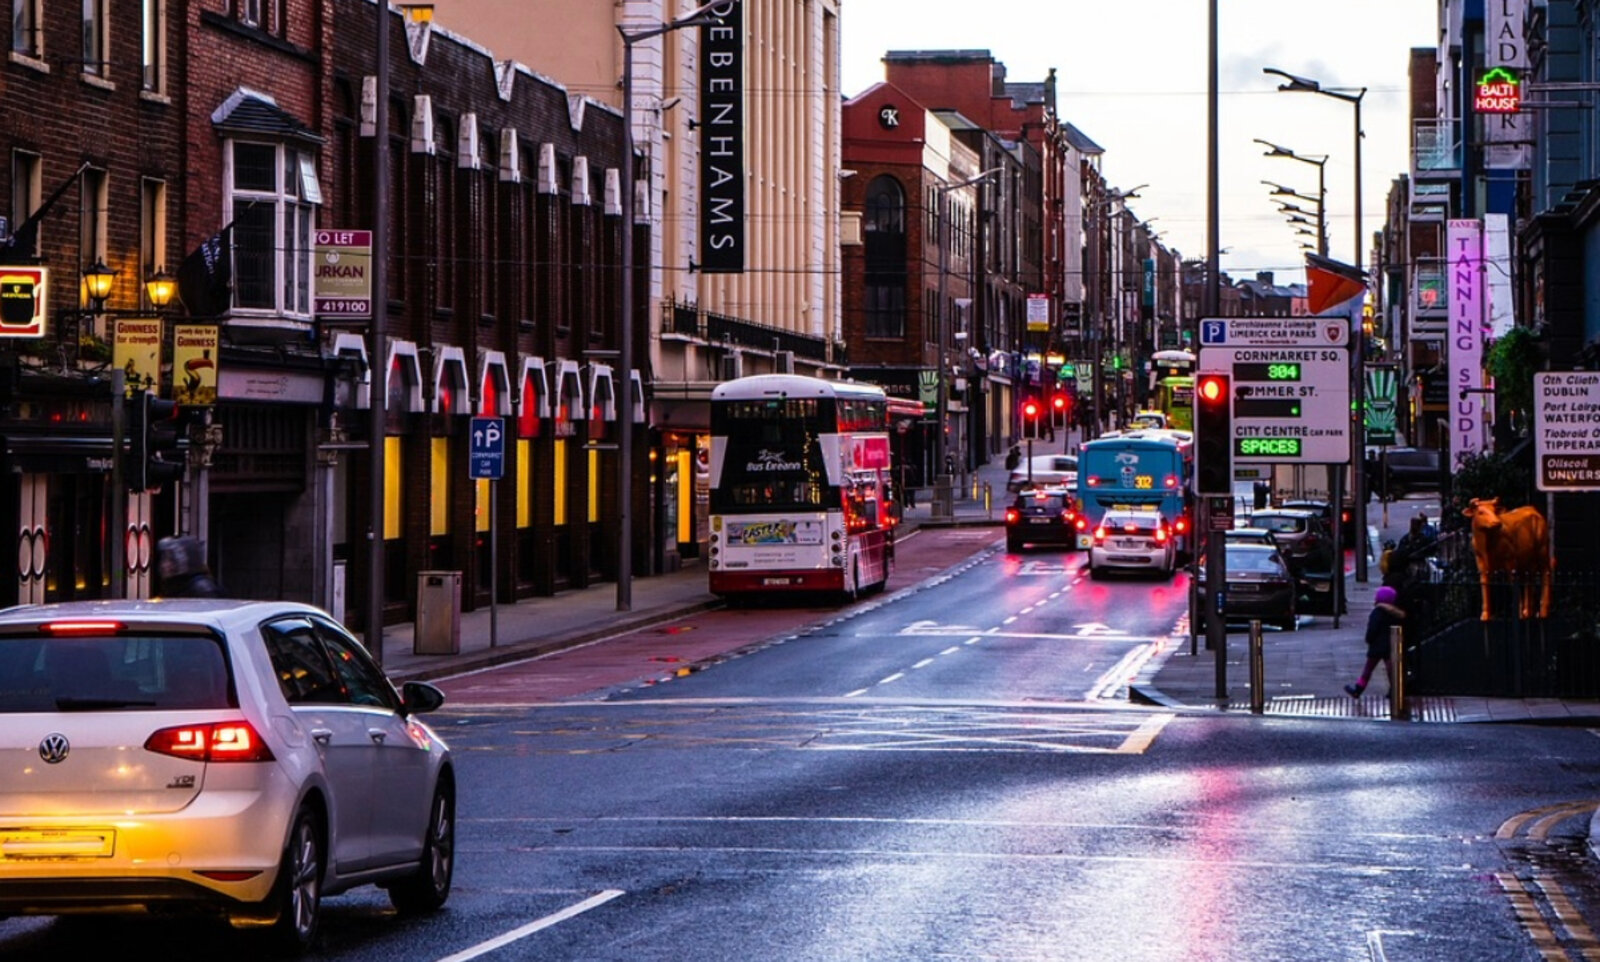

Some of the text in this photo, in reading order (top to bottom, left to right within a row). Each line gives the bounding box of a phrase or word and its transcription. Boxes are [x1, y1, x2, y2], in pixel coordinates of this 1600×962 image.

[1480, 84, 1514, 97] BALTI
[1475, 98, 1519, 110] HOUSE
[334, 232, 355, 245] LET
[1456, 237, 1473, 351] TANNING
[322, 302, 367, 312] 419100
[118, 323, 158, 333] GUINNESS
[1230, 330, 1317, 338] LIMERICK CAR PARKS
[129, 336, 158, 345] strength
[177, 336, 216, 347] GUINNESS
[1234, 351, 1341, 361] CORNMARKET SQ.
[1268, 365, 1298, 379] 304
[1246, 387, 1319, 397] UMMER ST.
[1544, 387, 1588, 397] DUBLIN
[1544, 402, 1566, 411] Port
[1235, 426, 1260, 436] CITY
[1264, 426, 1308, 437] CENTRE
[1545, 429, 1588, 438] Tiobraid
[486, 429, 500, 447] P
[1241, 440, 1298, 454] SPACES
[746, 462, 763, 471] Bus
